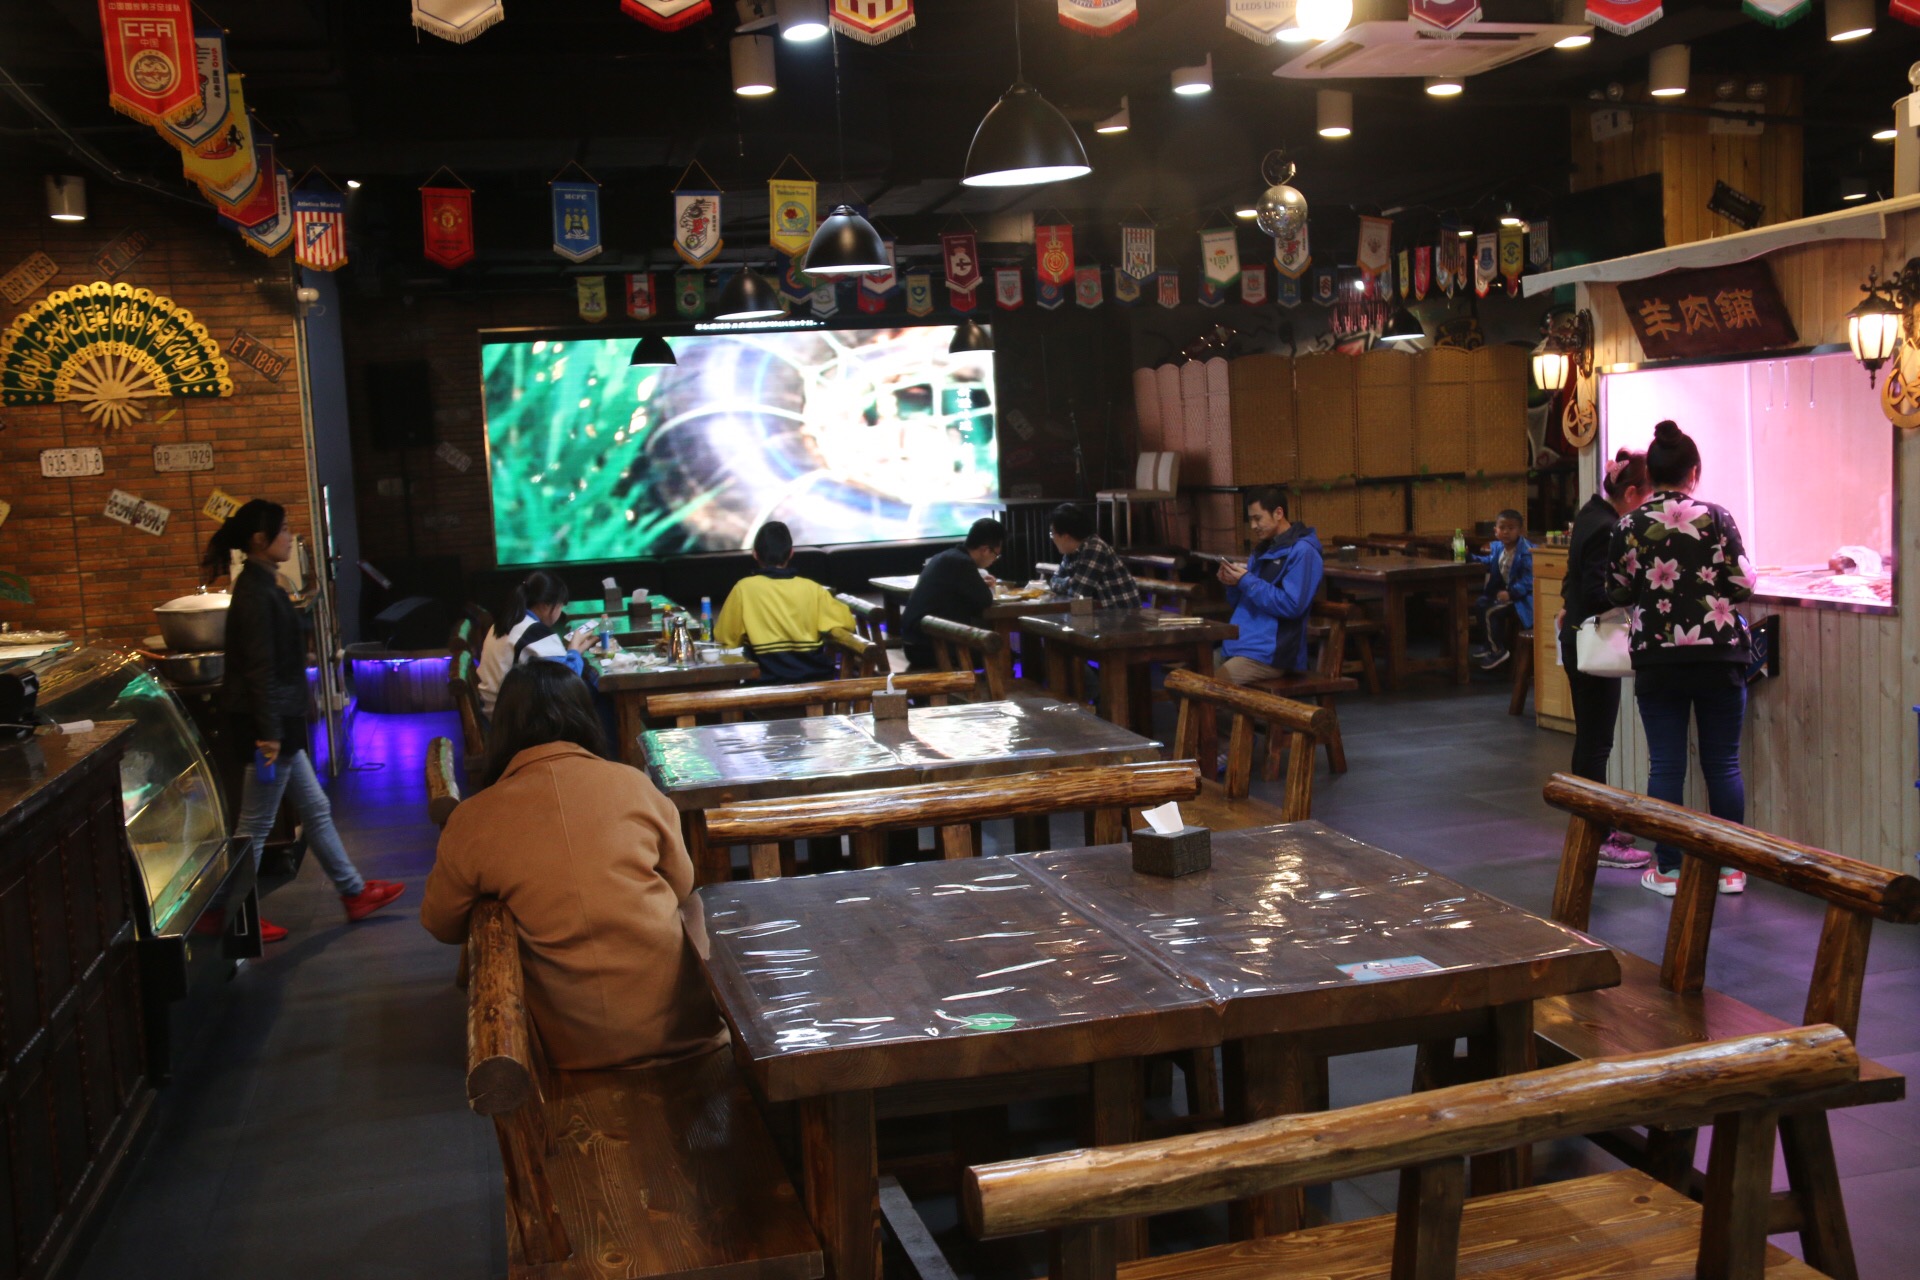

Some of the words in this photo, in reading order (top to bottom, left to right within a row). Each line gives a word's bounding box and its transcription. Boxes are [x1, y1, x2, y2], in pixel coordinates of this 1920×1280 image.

[1235, 3, 1261, 11] LEEDS
[1264, 1, 1296, 10] UNITE
[124, 22, 172, 38] CFA
[230, 336, 251, 357] ET
[251, 350, 282, 377] 1889
[156, 451, 170, 465] RR
[188, 450, 211, 465] 1929
